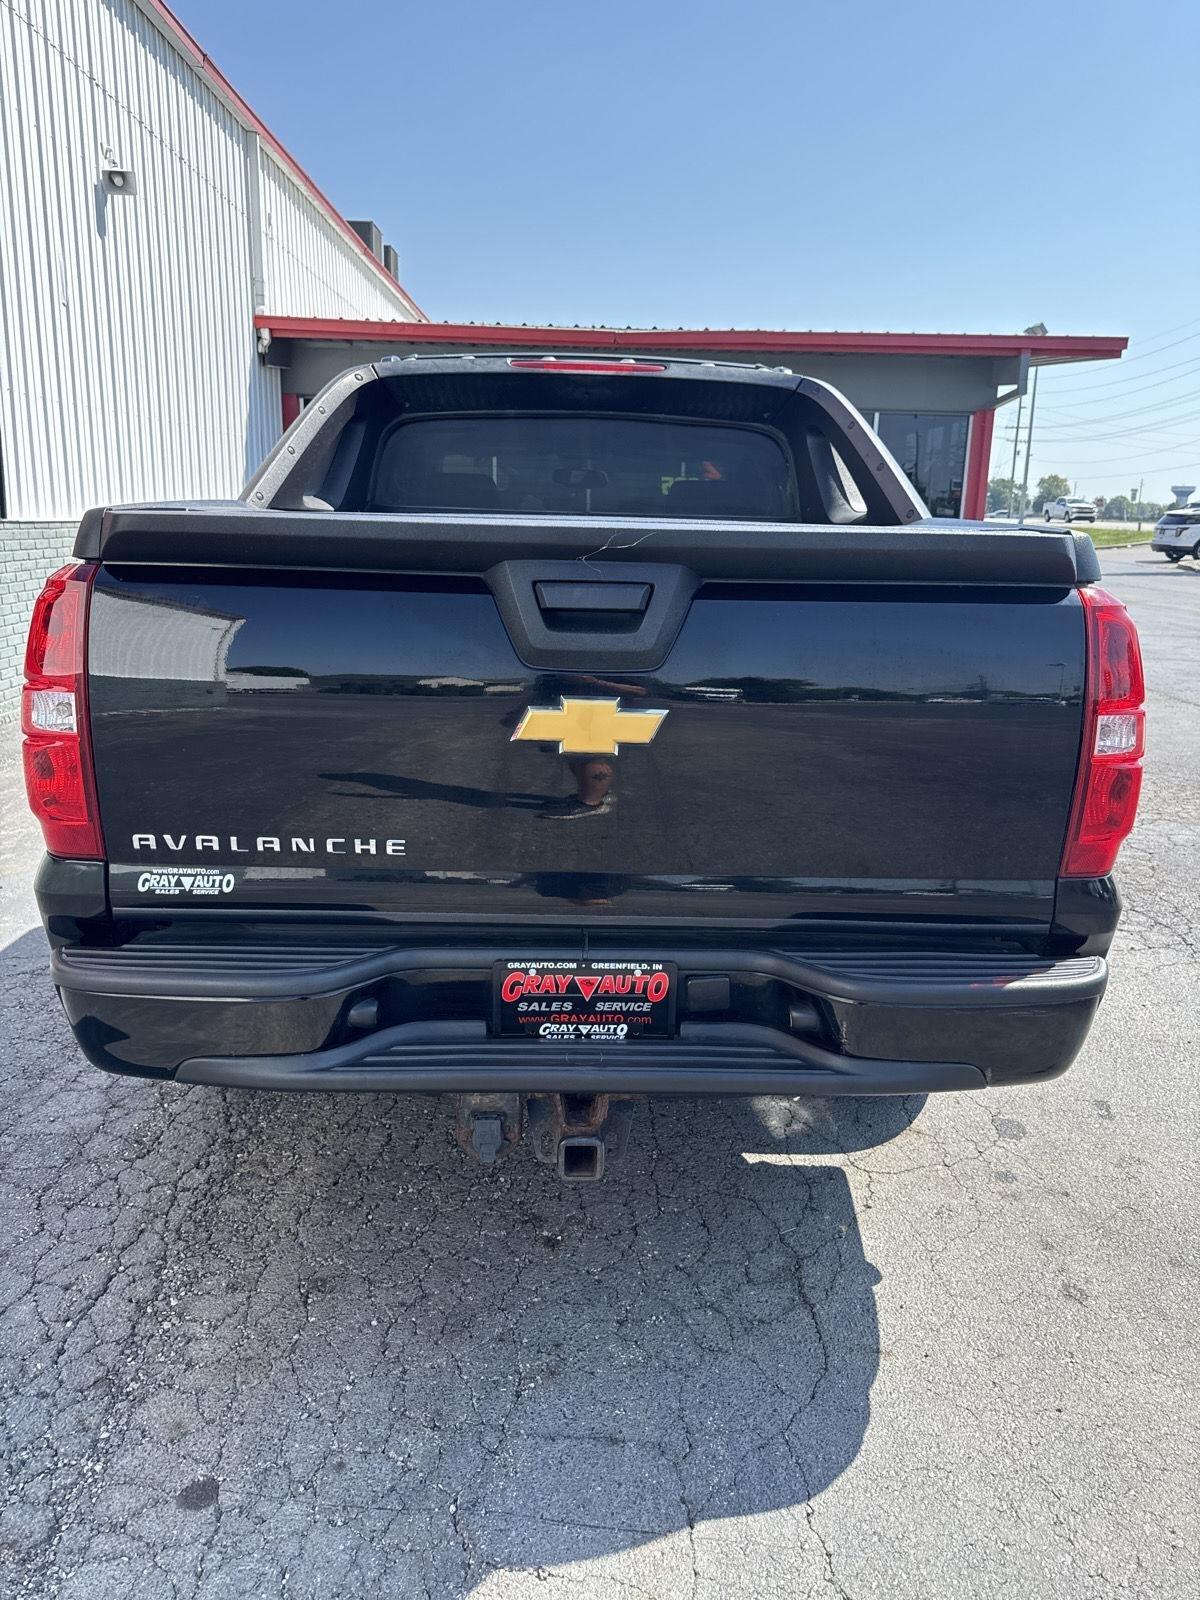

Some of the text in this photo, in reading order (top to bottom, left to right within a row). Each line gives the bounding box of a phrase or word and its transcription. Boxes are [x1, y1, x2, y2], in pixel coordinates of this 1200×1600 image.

[132, 833, 406, 855] AVALANCHE
[137, 873, 235, 893] GRAY AUTO
[501, 971, 669, 1002] GRAY AUTO
[517, 1002, 653, 1011] SALES SERVICE
[518, 1014, 652, 1024] wwwGRAYAUTOcom
[539, 1023, 628, 1036] GRAY AUTO
